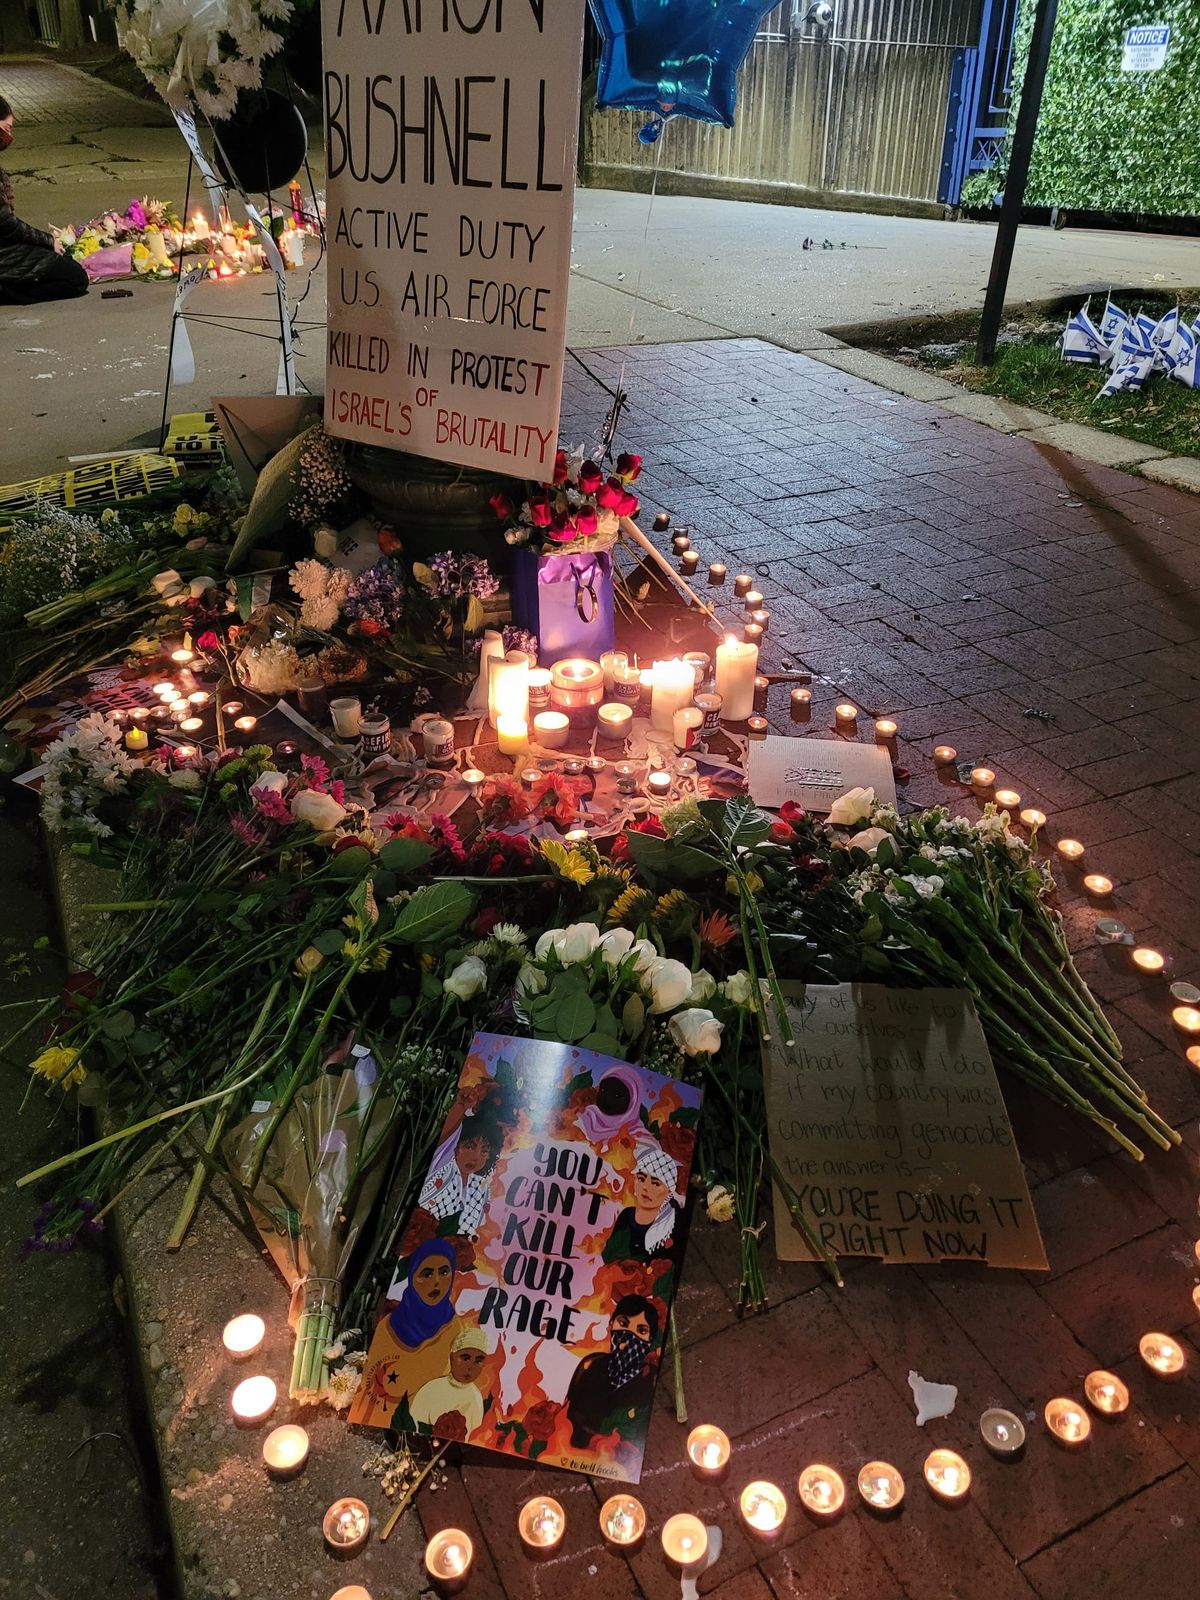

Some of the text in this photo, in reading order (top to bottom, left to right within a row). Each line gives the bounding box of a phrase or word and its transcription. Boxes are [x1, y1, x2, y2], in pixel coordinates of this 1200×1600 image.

[1128, 30, 1166, 44] NOTICE
[325, 71, 563, 191] BUSHNELL
[335, 207, 546, 263] ACTIVE DUTY
[340, 267, 383, 307] U.S.
[400, 270, 450, 318] AIR
[467, 278, 551, 332] FORCE
[329, 330, 550, 396] KILLED IN PROTEST
[415, 386, 439, 407] OF
[331, 388, 553, 463] ISRAEL'S BRUTALITY
[784, 992, 817, 1015] any
[829, 990, 848, 1010] of
[857, 992, 877, 1011] us
[930, 996, 957, 1018] to
[792, 1013, 814, 1033] sk
[857, 1049, 926, 1074] would
[953, 1053, 987, 1076] do
[786, 1074, 997, 1117] if my country was
[778, 1116, 902, 1159] committing
[533, 1142, 602, 1188] YOU
[783, 1154, 818, 1176] the
[824, 1160, 889, 1176] answer
[504, 1176, 609, 1225] CAN'T
[896, 1189, 981, 1225] DOING
[989, 1197, 1024, 1229] IT
[819, 1221, 988, 1259] RIGHT NOW
[503, 1250, 574, 1301] OUR
[478, 1286, 582, 1346] RAGE
[569, 1459, 578, 1469] to
[580, 1461, 596, 1473] bell
